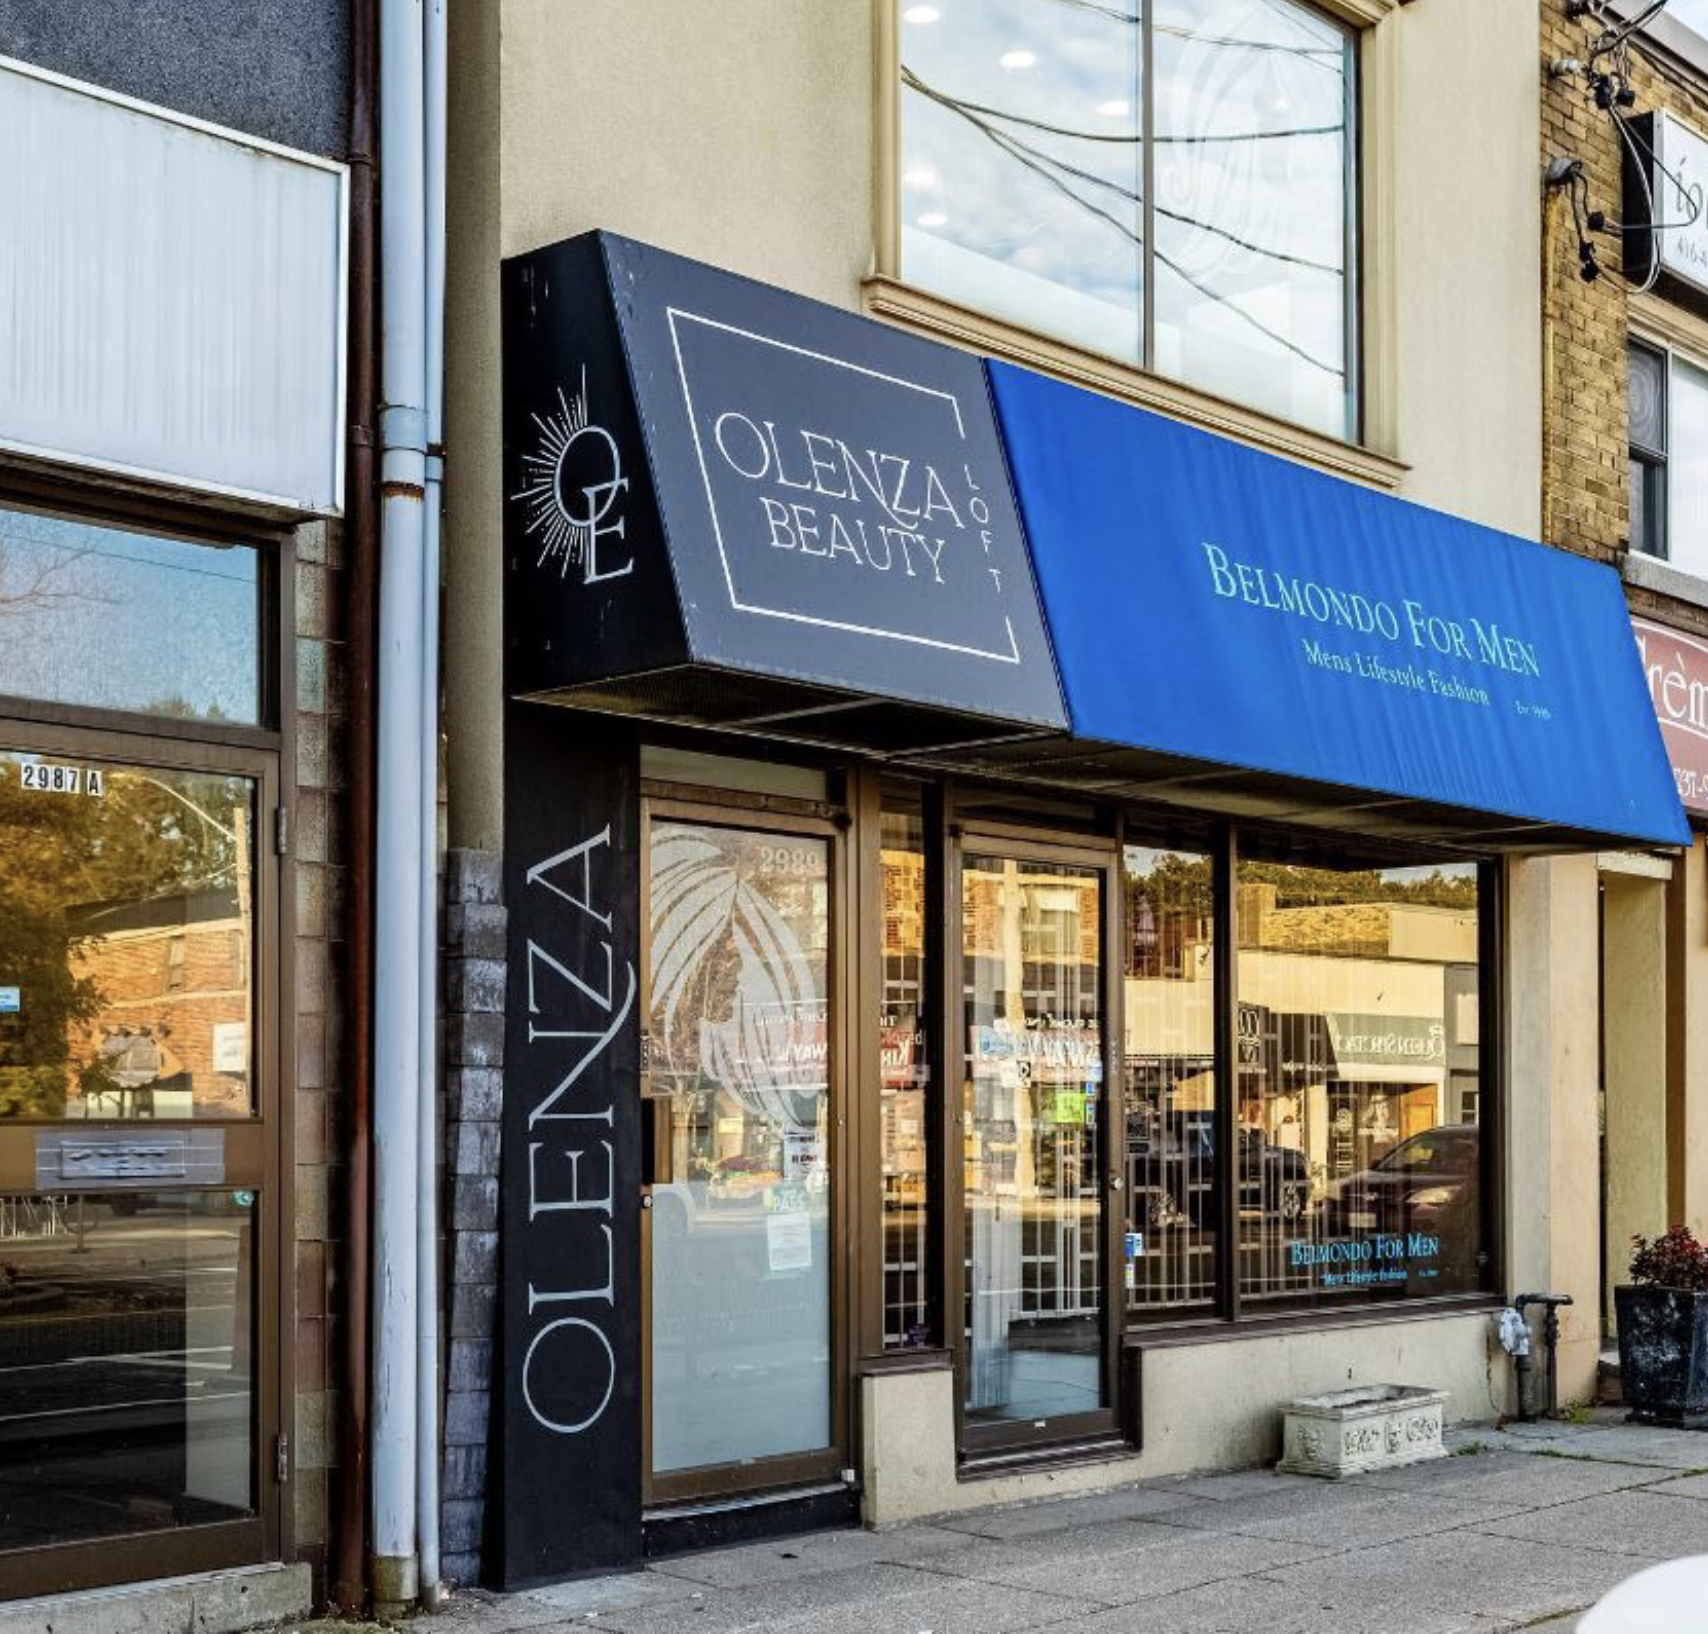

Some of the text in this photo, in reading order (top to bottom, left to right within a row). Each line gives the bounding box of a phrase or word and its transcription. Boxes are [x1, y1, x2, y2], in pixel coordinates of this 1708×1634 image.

[714, 412, 966, 529] OLENZA
[759, 497, 945, 584] BEAUTY
[964, 464, 1001, 593] LOFT
[1201, 542, 1541, 677] BELMONDO FOR MEN
[1302, 639, 1491, 706] Mens Lifestyle Fashion
[23, 765, 99, 794] 2987 A
[523, 823, 637, 1433] OLENZA
[1291, 1241, 1372, 1265] BELMONDO
